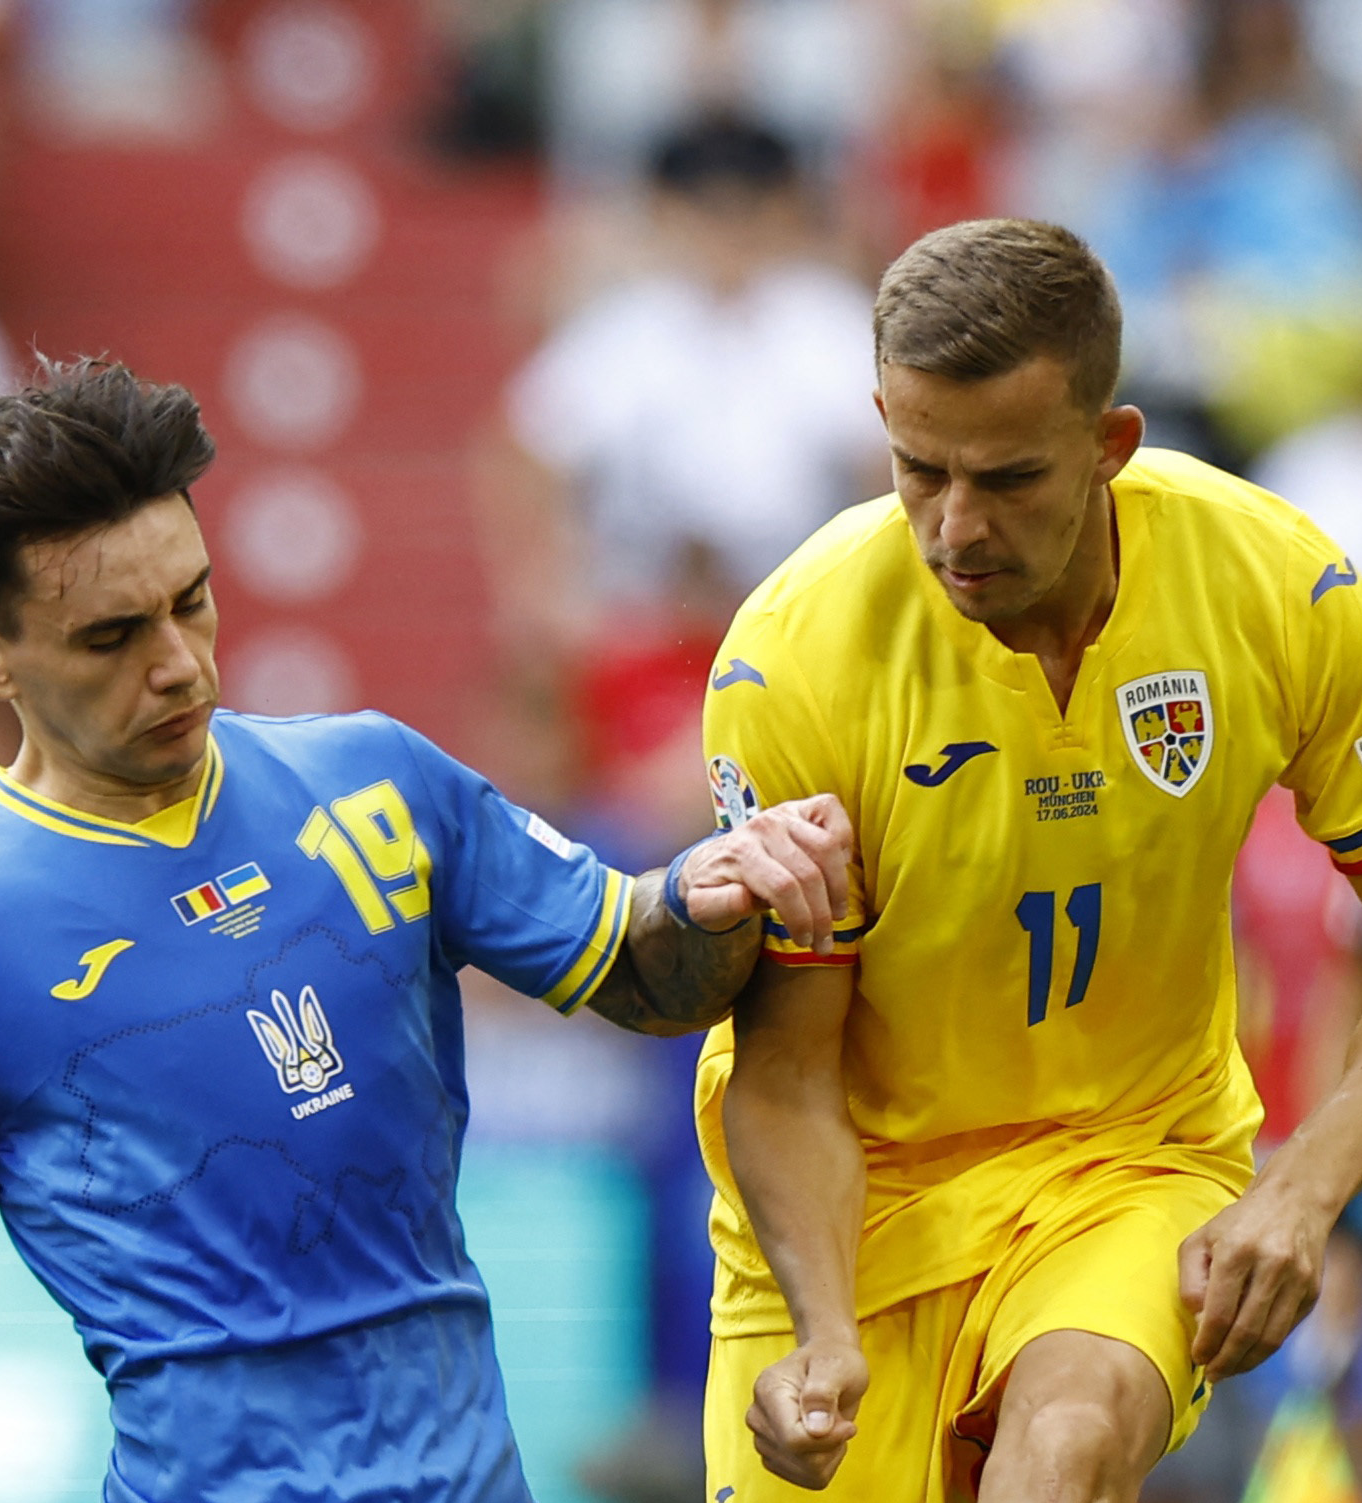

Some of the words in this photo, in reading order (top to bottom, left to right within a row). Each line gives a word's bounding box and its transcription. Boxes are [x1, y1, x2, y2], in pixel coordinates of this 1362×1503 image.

[1125, 675, 1199, 708] ROMÂNIA
[1024, 776, 1060, 796] ROU
[1071, 770, 1106, 790] UKR
[1038, 791, 1095, 808] MÜNCHEN
[1036, 804, 1098, 822] 17.06.2024
[296, 779, 432, 935] 19
[1015, 882, 1102, 1027] 11
[290, 1083, 355, 1120] UKRAINE
